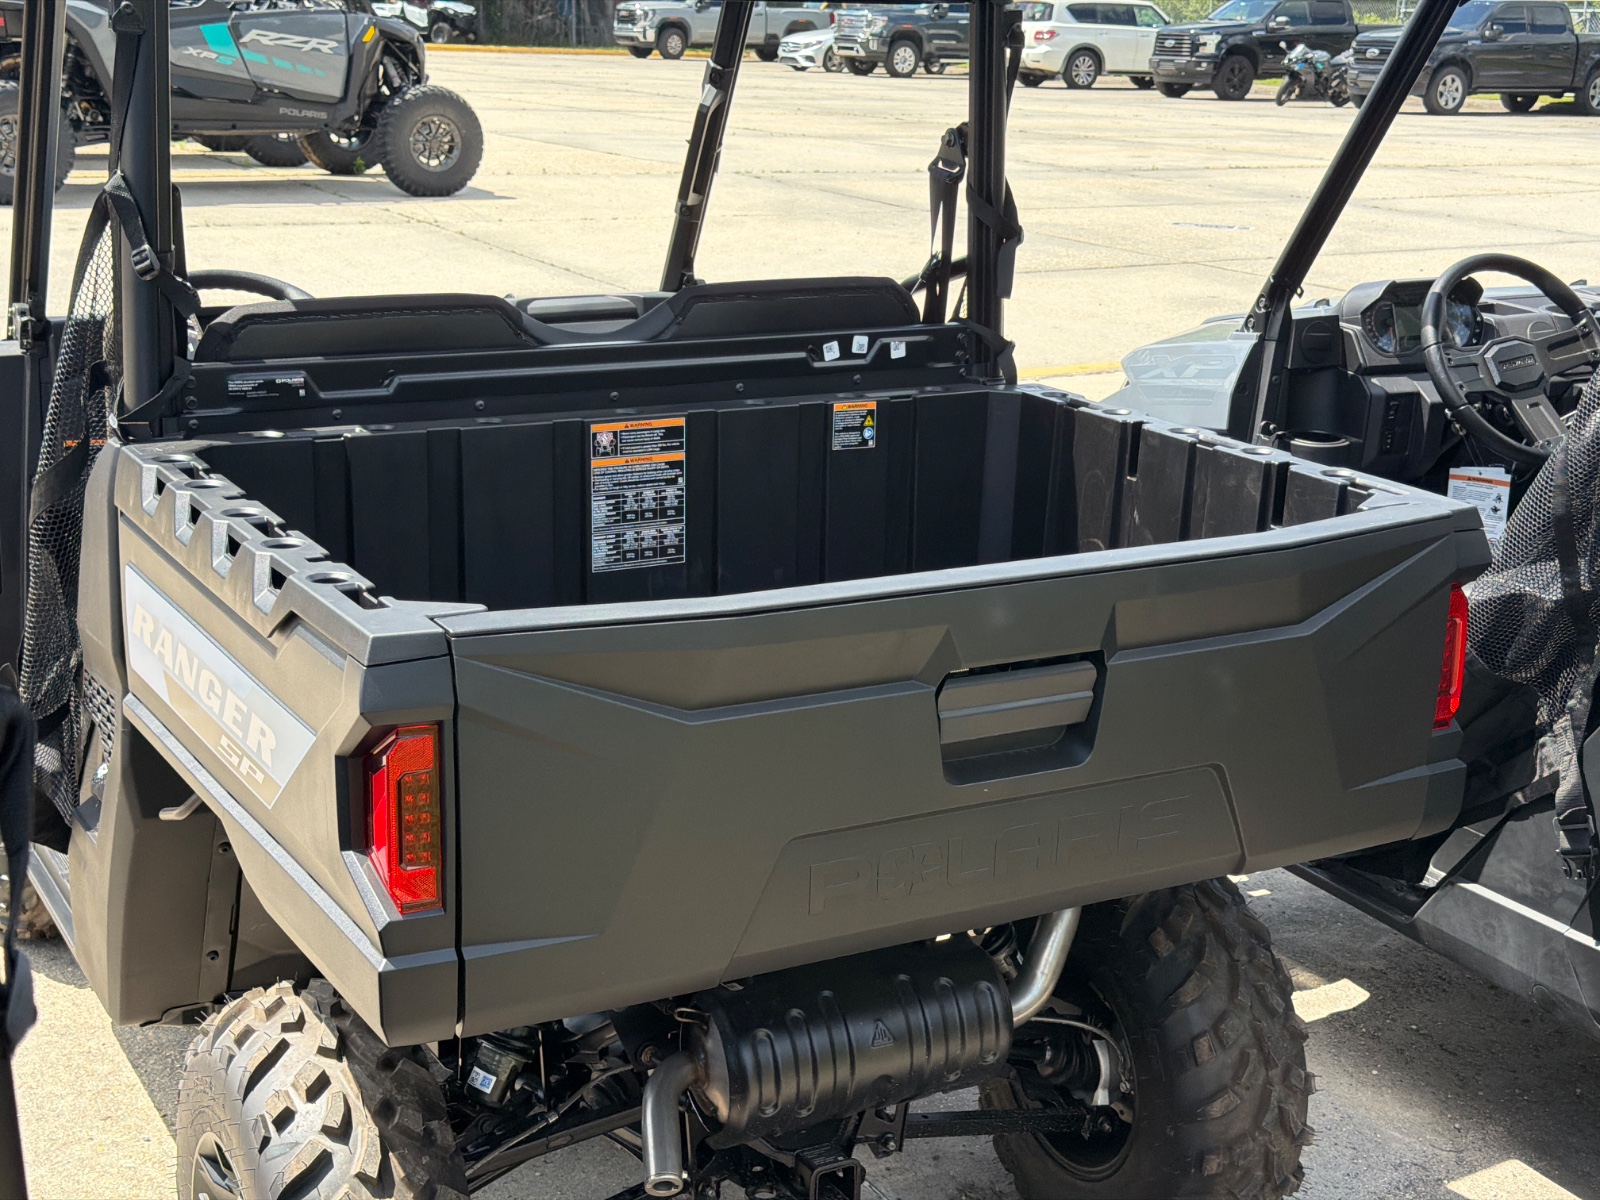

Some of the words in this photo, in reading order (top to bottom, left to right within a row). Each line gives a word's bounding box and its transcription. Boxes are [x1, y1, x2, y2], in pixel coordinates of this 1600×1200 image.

[239, 29, 339, 54] RZR
[279, 107, 328, 119] POLARIS
[1136, 354, 1237, 378] XP
[132, 602, 277, 768] RANGER
[217, 735, 265, 784] SP
[808, 795, 1191, 916] POLARIS
